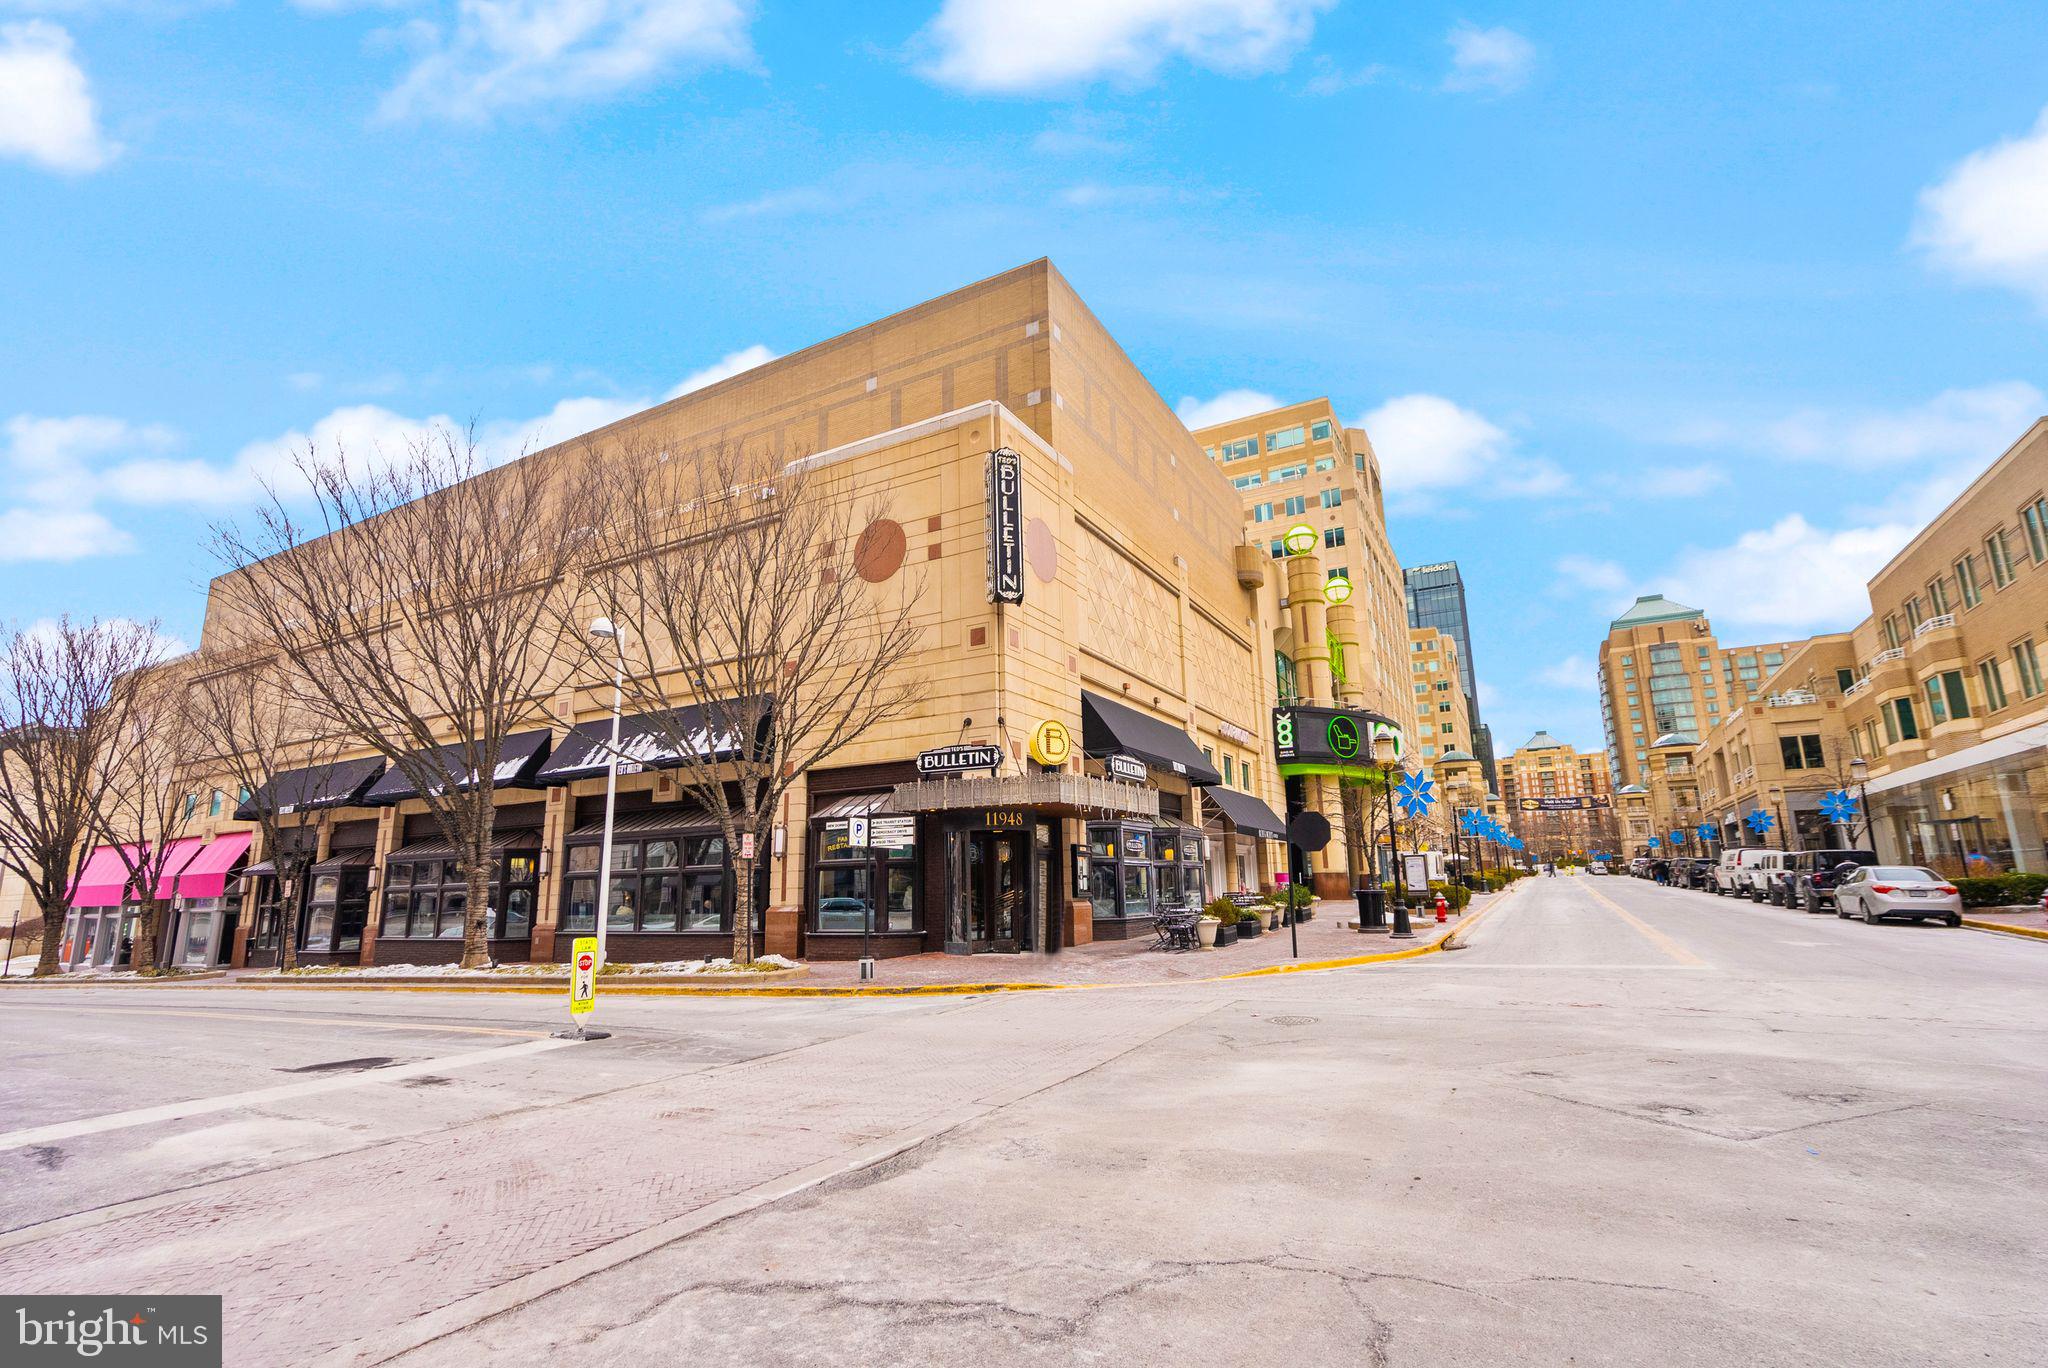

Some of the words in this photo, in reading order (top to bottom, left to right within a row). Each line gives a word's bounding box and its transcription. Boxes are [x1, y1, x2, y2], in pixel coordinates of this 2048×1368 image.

[1000, 465, 1017, 590] BULLETIN
[1276, 712, 1294, 749] LOOK
[1044, 727, 1066, 756] B
[924, 751, 991, 769] BULLETIN
[1115, 760, 1144, 778] BULLETIN
[984, 812, 1023, 826] 11948
[856, 824, 862, 834] P
